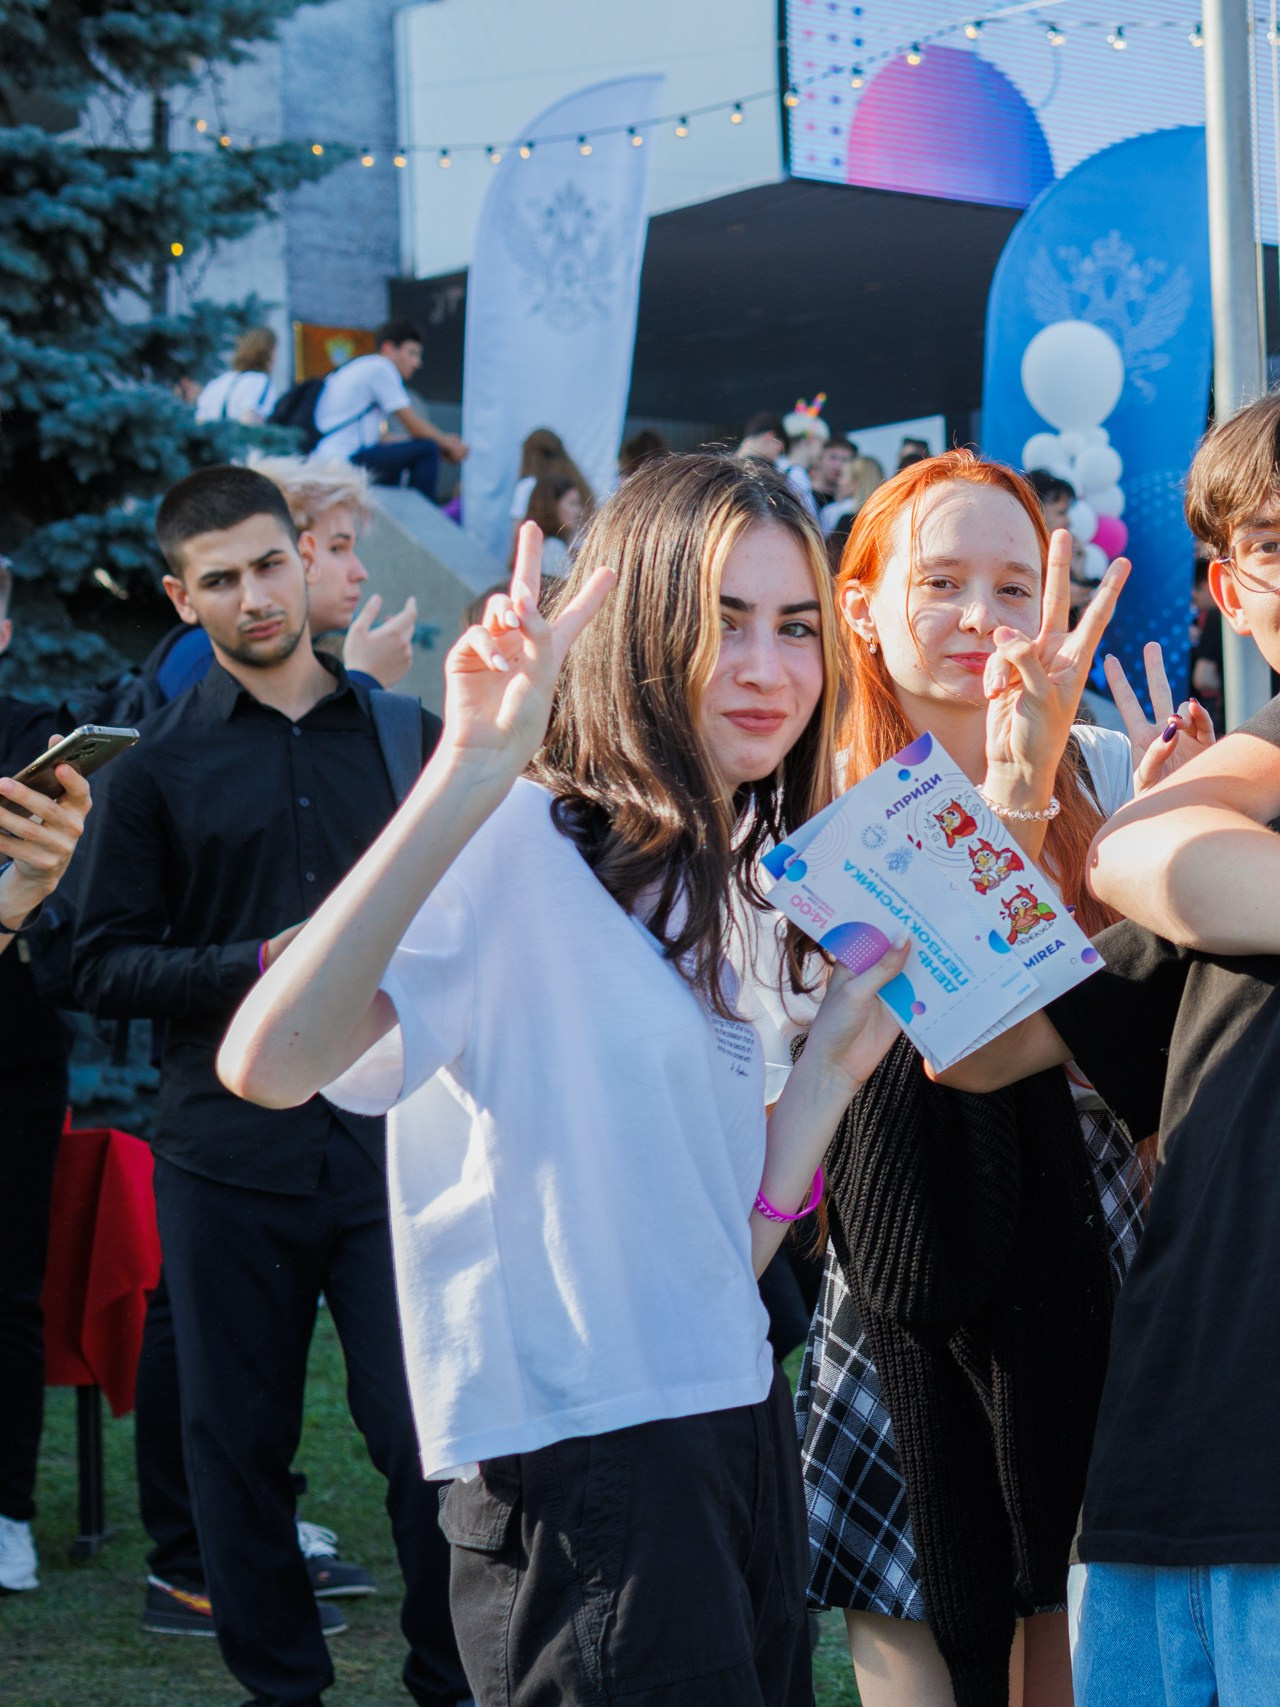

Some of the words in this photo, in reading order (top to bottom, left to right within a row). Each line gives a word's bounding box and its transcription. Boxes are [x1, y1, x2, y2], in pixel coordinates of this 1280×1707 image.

[885, 774, 942, 820] АПРИДИ
[790, 894, 828, 928] 14:00
[842, 858, 969, 986] ПЕРВОКУРСНИКА
[917, 948, 959, 994] ДЕНЬ
[1022, 939, 1065, 969] MIREA
